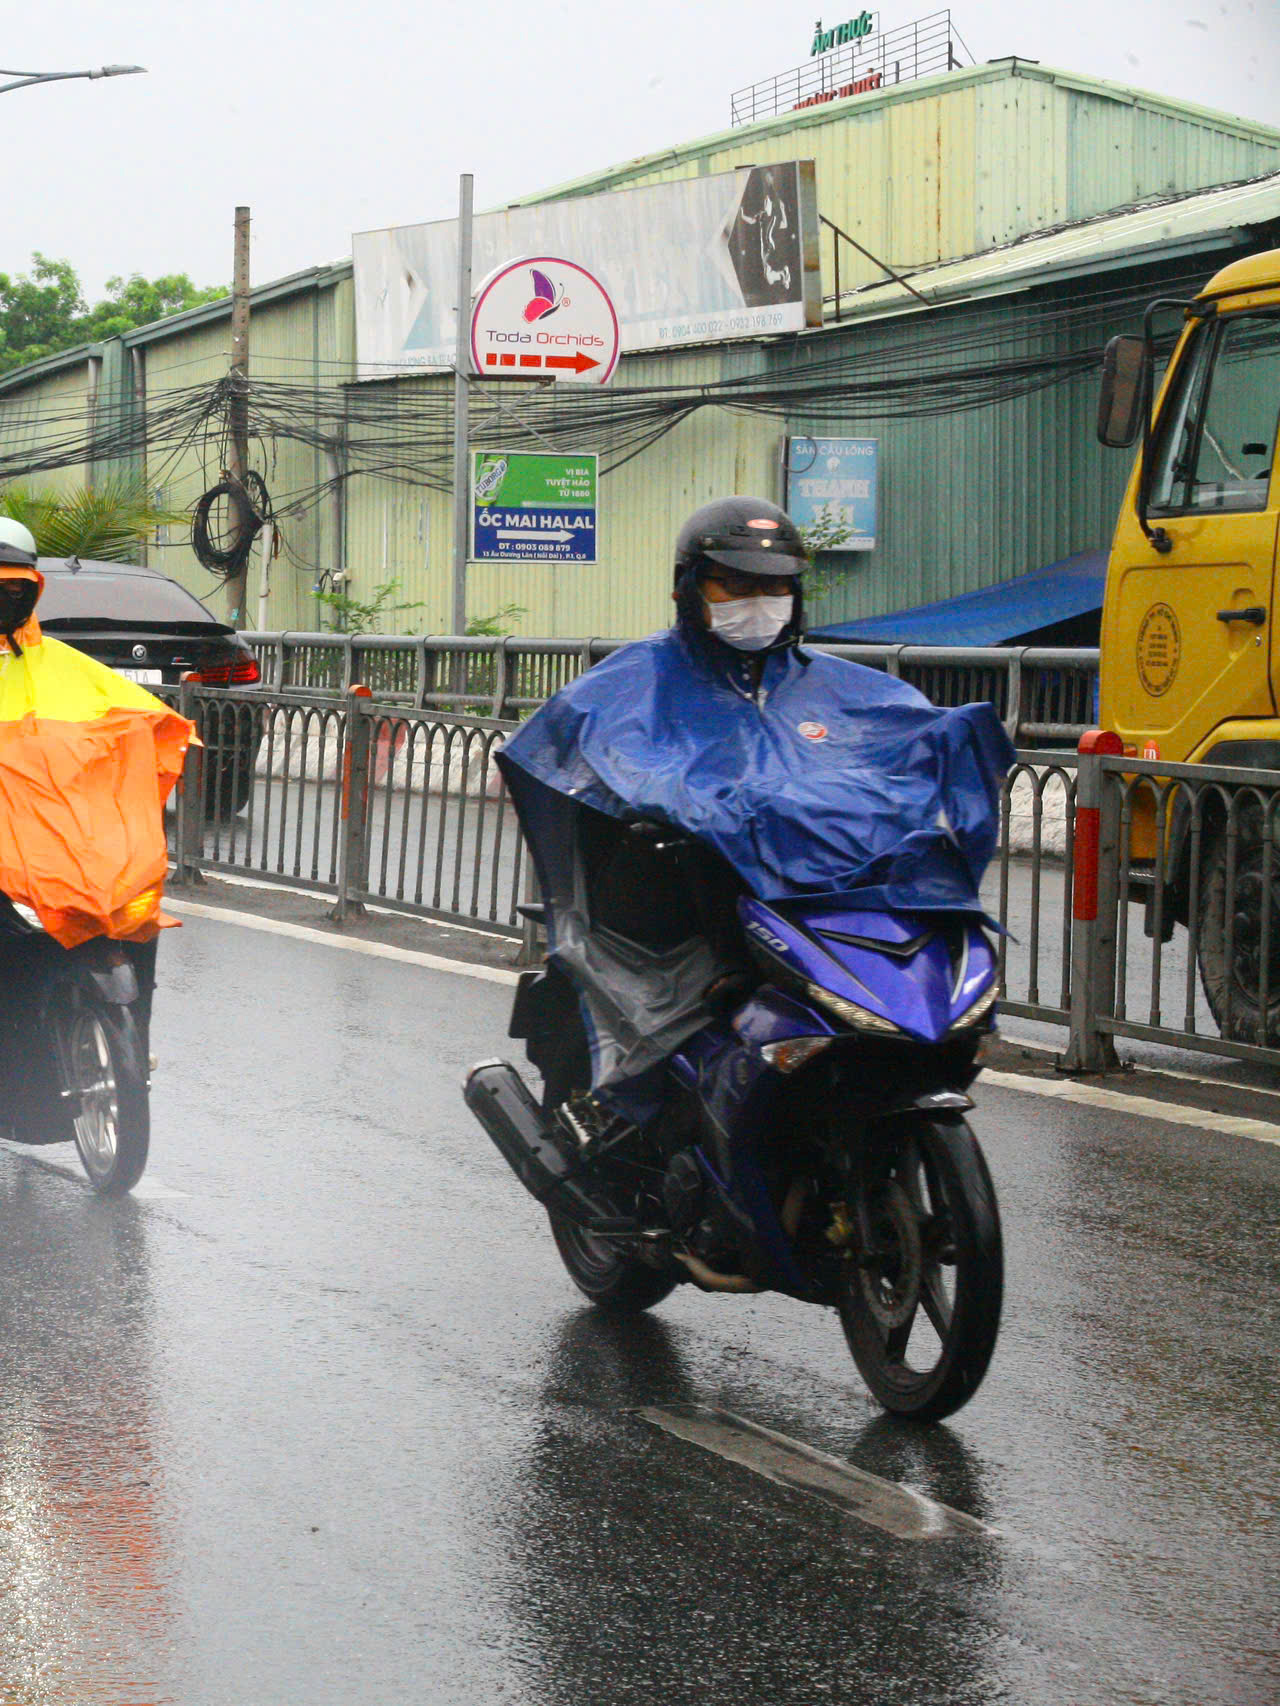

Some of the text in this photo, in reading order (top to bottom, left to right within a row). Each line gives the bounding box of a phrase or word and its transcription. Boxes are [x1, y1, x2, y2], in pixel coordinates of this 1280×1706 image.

[486, 330, 605, 347] Toda Orchids
[478, 508, 594, 529] ỐC MAI HALAL
[515, 543, 537, 551] 0903
[745, 921, 790, 952] 150
